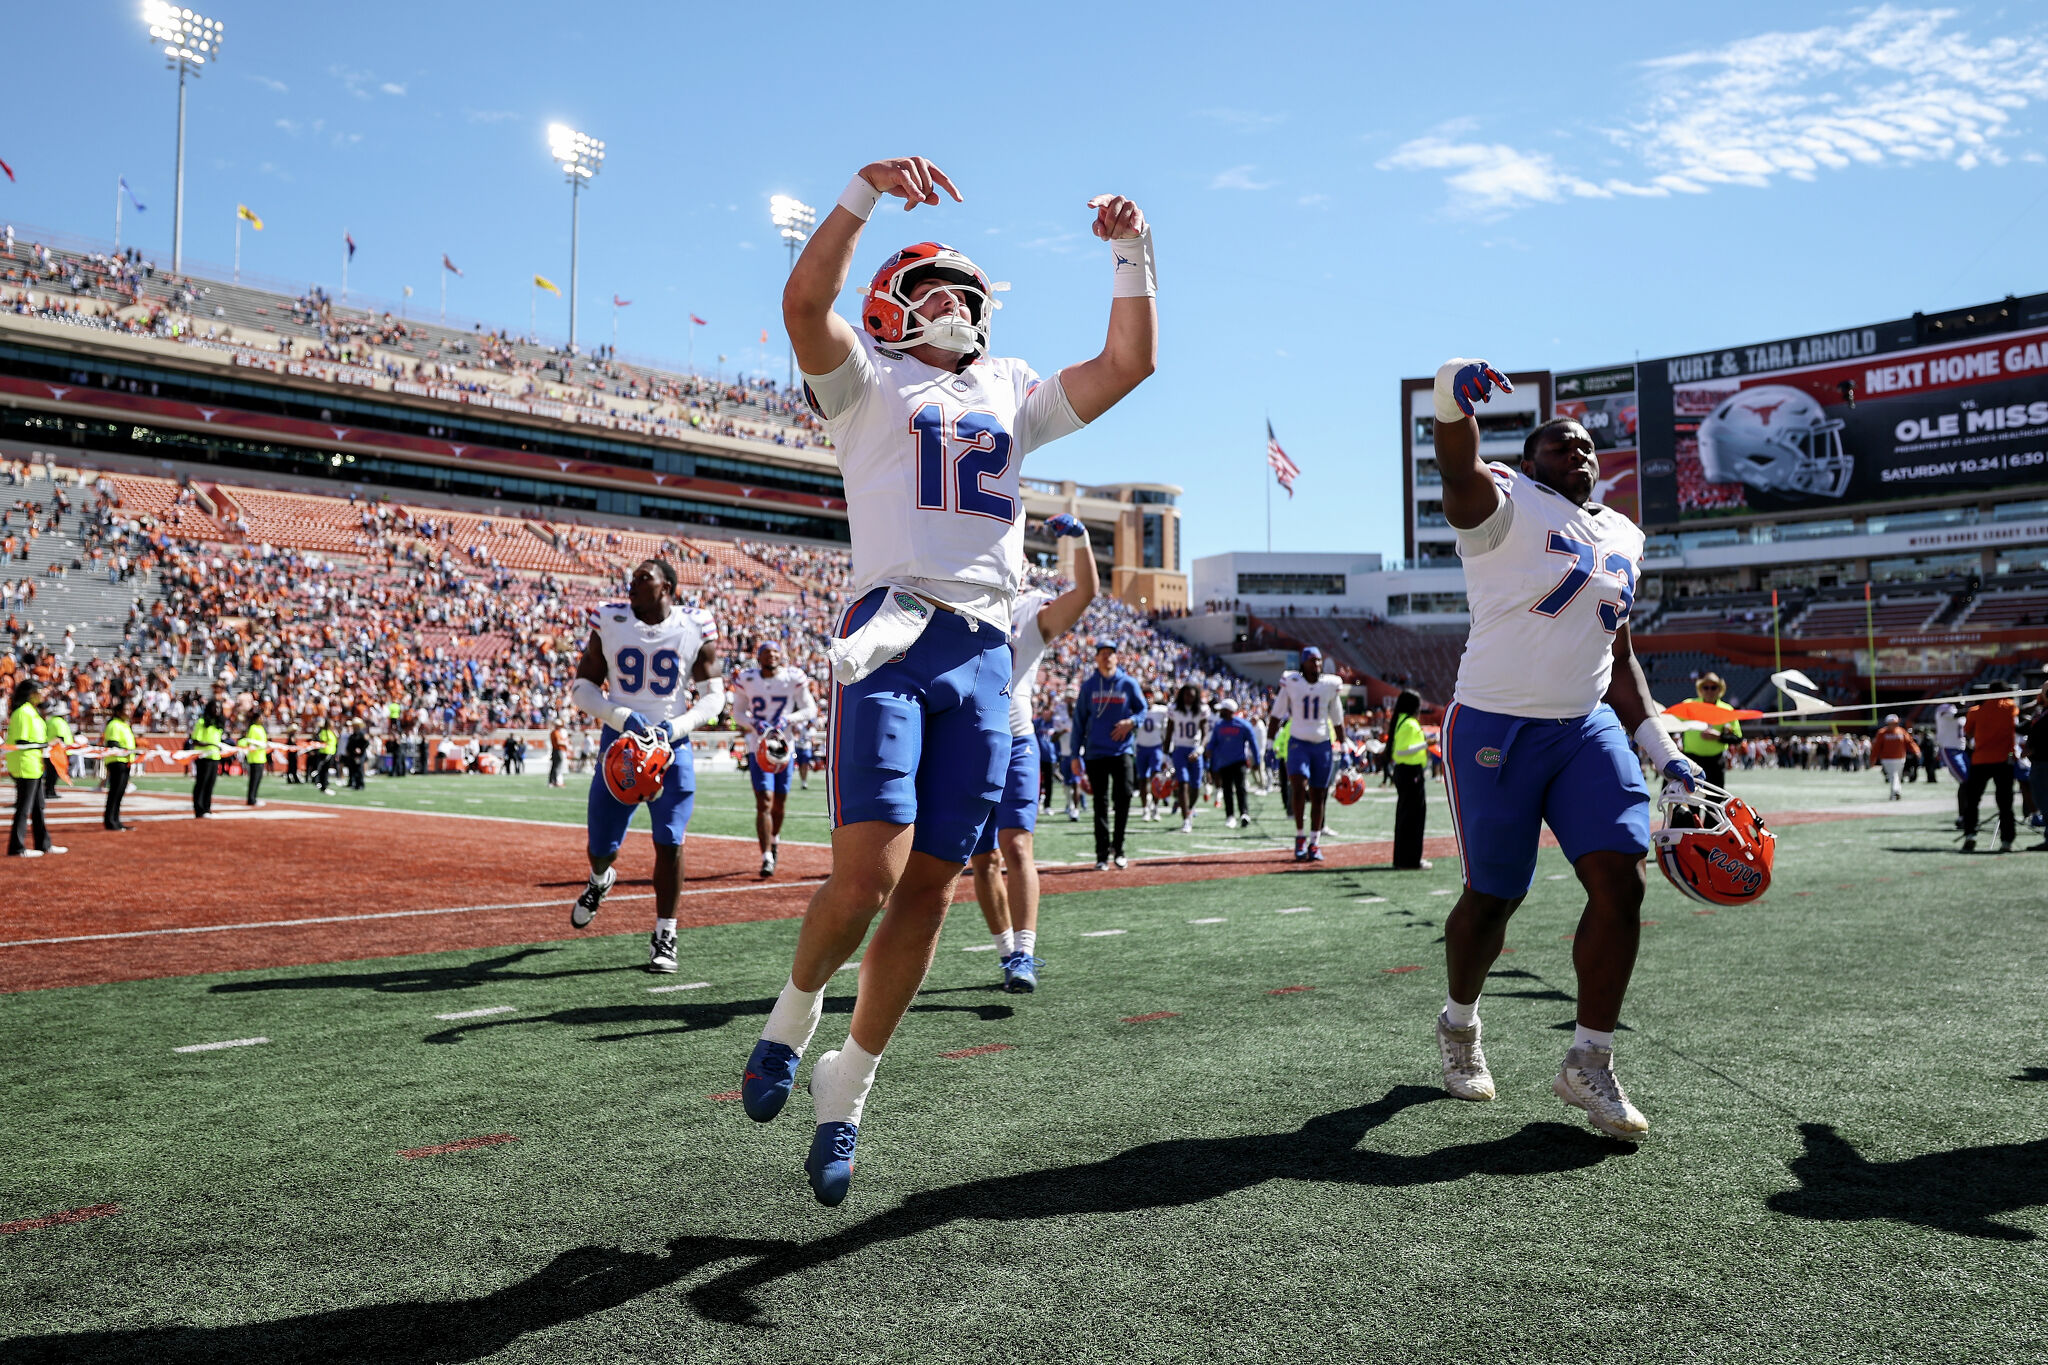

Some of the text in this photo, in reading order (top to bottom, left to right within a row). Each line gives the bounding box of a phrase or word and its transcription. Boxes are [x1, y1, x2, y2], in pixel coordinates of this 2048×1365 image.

[1667, 355, 1716, 384] KURT
[1720, 351, 1740, 376] &
[1744, 343, 1794, 373] TARA
[1798, 329, 1876, 366] ARNOLD
[1865, 341, 2048, 394] NEXT HOME GA
[1895, 401, 2048, 442] OLE MISS
[909, 401, 1015, 526] 12
[1881, 460, 1957, 482] SATURDAY
[1960, 456, 1999, 474] 10.24
[2009, 451, 2045, 468] 6:30
[1528, 530, 1637, 634] 73
[615, 645, 680, 698] 99
[752, 695, 789, 724] 27
[1178, 720, 1197, 740] 10
[1302, 695, 1320, 720] 11
[1708, 847, 1763, 894] Gators
